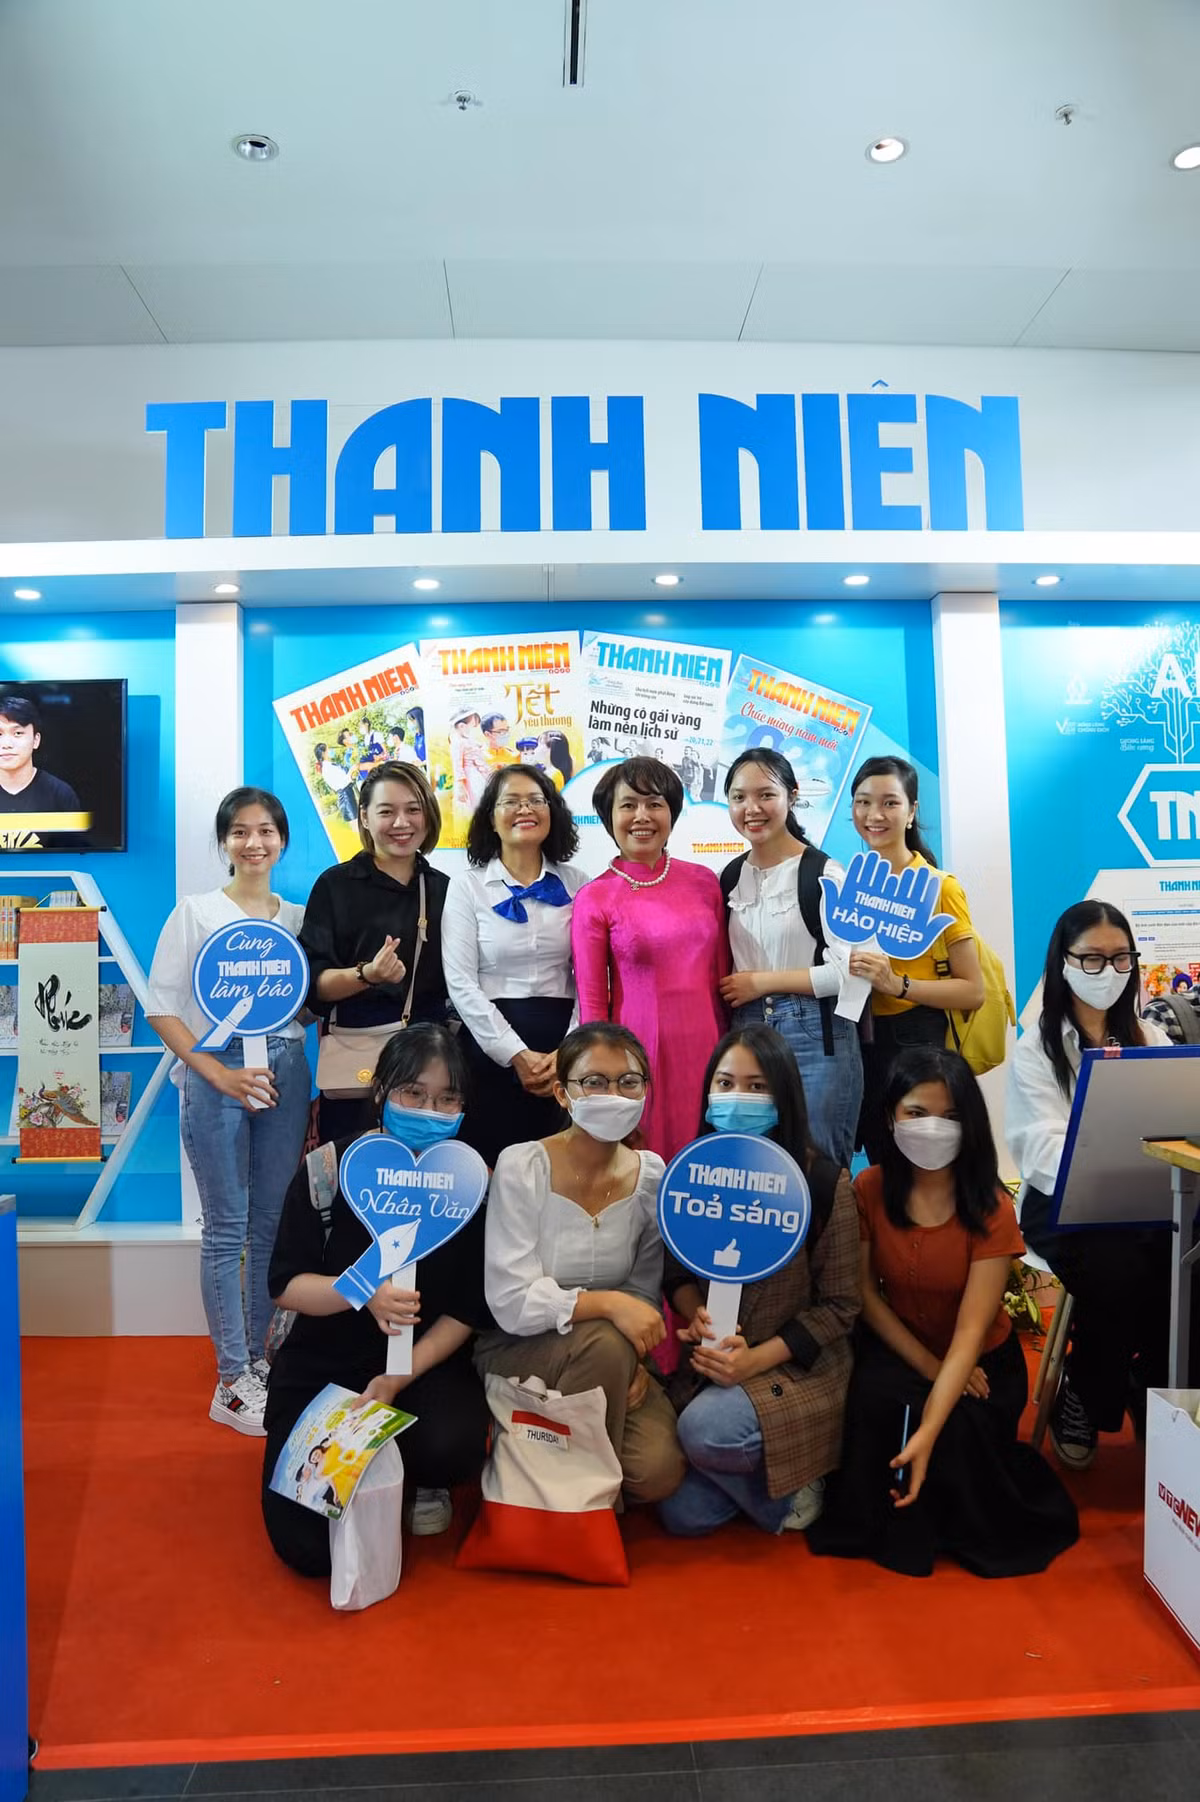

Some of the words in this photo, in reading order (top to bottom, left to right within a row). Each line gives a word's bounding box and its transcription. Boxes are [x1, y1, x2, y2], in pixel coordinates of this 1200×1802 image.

[145, 396, 646, 538] THANH
[698, 380, 1024, 531] NIÊN
[438, 645, 515, 675] THANH
[597, 641, 671, 676] THANH
[504, 681, 560, 725] Tết
[747, 668, 815, 714] THANH
[290, 683, 367, 733] THANH
[590, 700, 631, 720] Những
[633, 707, 647, 720] cô
[649, 709, 669, 724] gái
[671, 712, 702, 730] vàng
[740, 701, 767, 723] Chúc
[795, 727, 818, 744] năm
[588, 715, 612, 731] làm
[614, 720, 638, 735] nên
[640, 722, 662, 740] lịch
[664, 727, 680, 740] sử
[1159, 880, 1191, 892] THANH
[855, 891, 892, 913] THANH
[832, 906, 875, 930] HÀO
[877, 921, 924, 944] HIỆP
[226, 931, 276, 958] Cùng
[217, 960, 260, 976] THANH
[210, 977, 251, 999] làm
[257, 976, 293, 997] báo
[376, 1168, 422, 1188] THANH
[688, 1163, 746, 1190] THANH
[357, 1188, 422, 1216] Nhân
[429, 1194, 470, 1219] Văn
[668, 1191, 723, 1219] Toả
[729, 1200, 800, 1234] sáng
